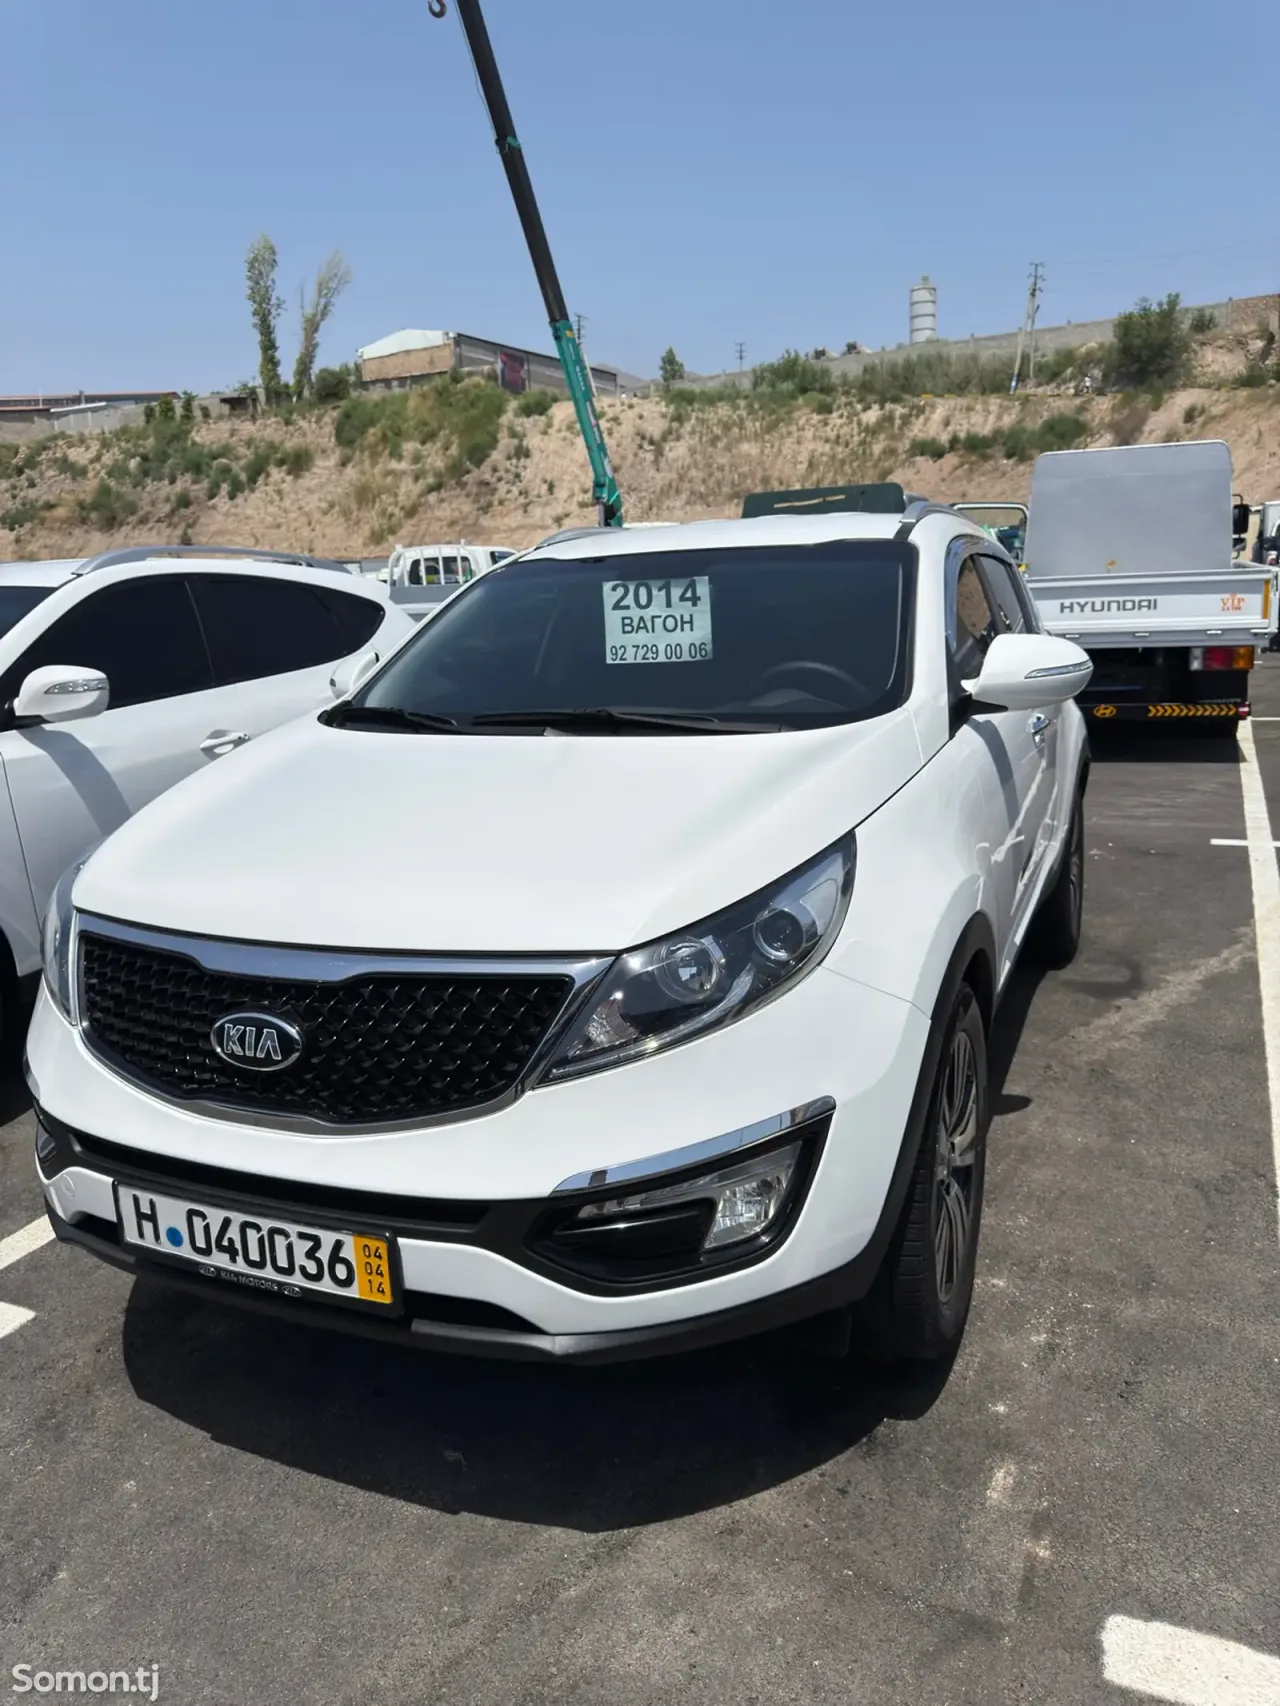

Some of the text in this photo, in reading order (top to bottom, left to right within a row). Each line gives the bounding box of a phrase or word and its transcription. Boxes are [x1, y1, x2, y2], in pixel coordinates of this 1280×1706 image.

[611, 579, 701, 611] 2014
[1060, 598, 1158, 614] HYUNDAI
[621, 613, 694, 634] ВАГОН
[610, 642, 708, 661] 92 729 00 06
[223, 1023, 282, 1060] KIA
[132, 1193, 355, 1288] H 040036
[362, 1243, 383, 1260] 04
[364, 1261, 384, 1278] 04
[367, 1278, 386, 1296] 14
